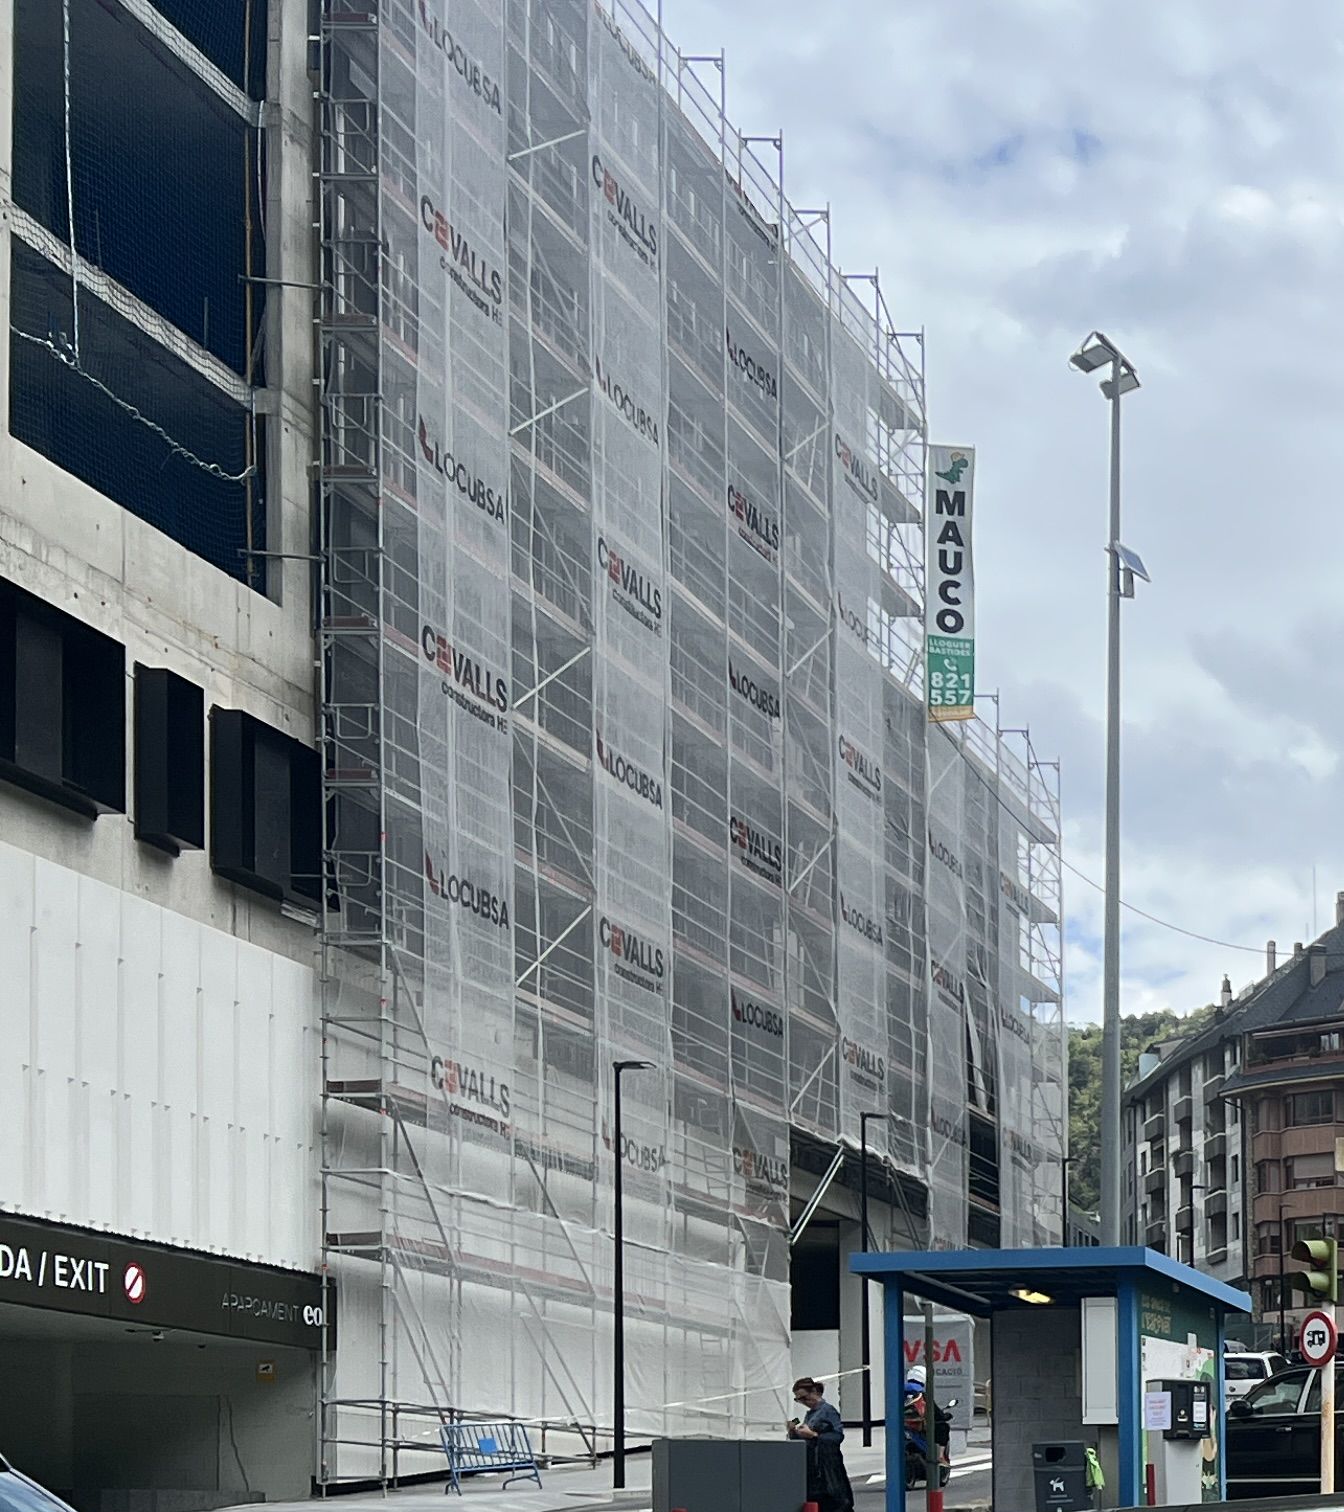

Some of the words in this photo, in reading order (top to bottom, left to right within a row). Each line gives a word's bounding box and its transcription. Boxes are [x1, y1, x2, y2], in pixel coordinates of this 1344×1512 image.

[434, 17, 502, 115] LOCUBSA
[435, 442, 505, 525] LOCUBSA
[935, 489, 966, 634] MAUCO
[930, 671, 970, 689] 821
[930, 689, 971, 706] 557
[609, 750, 663, 811] LOCUBSA
[441, 869, 510, 930] LOCUBSA
[742, 1001, 784, 1038] LOCUBSA
[616, 1131, 667, 1174] OCUBSA
[54, 1254, 110, 1293] EXIT
